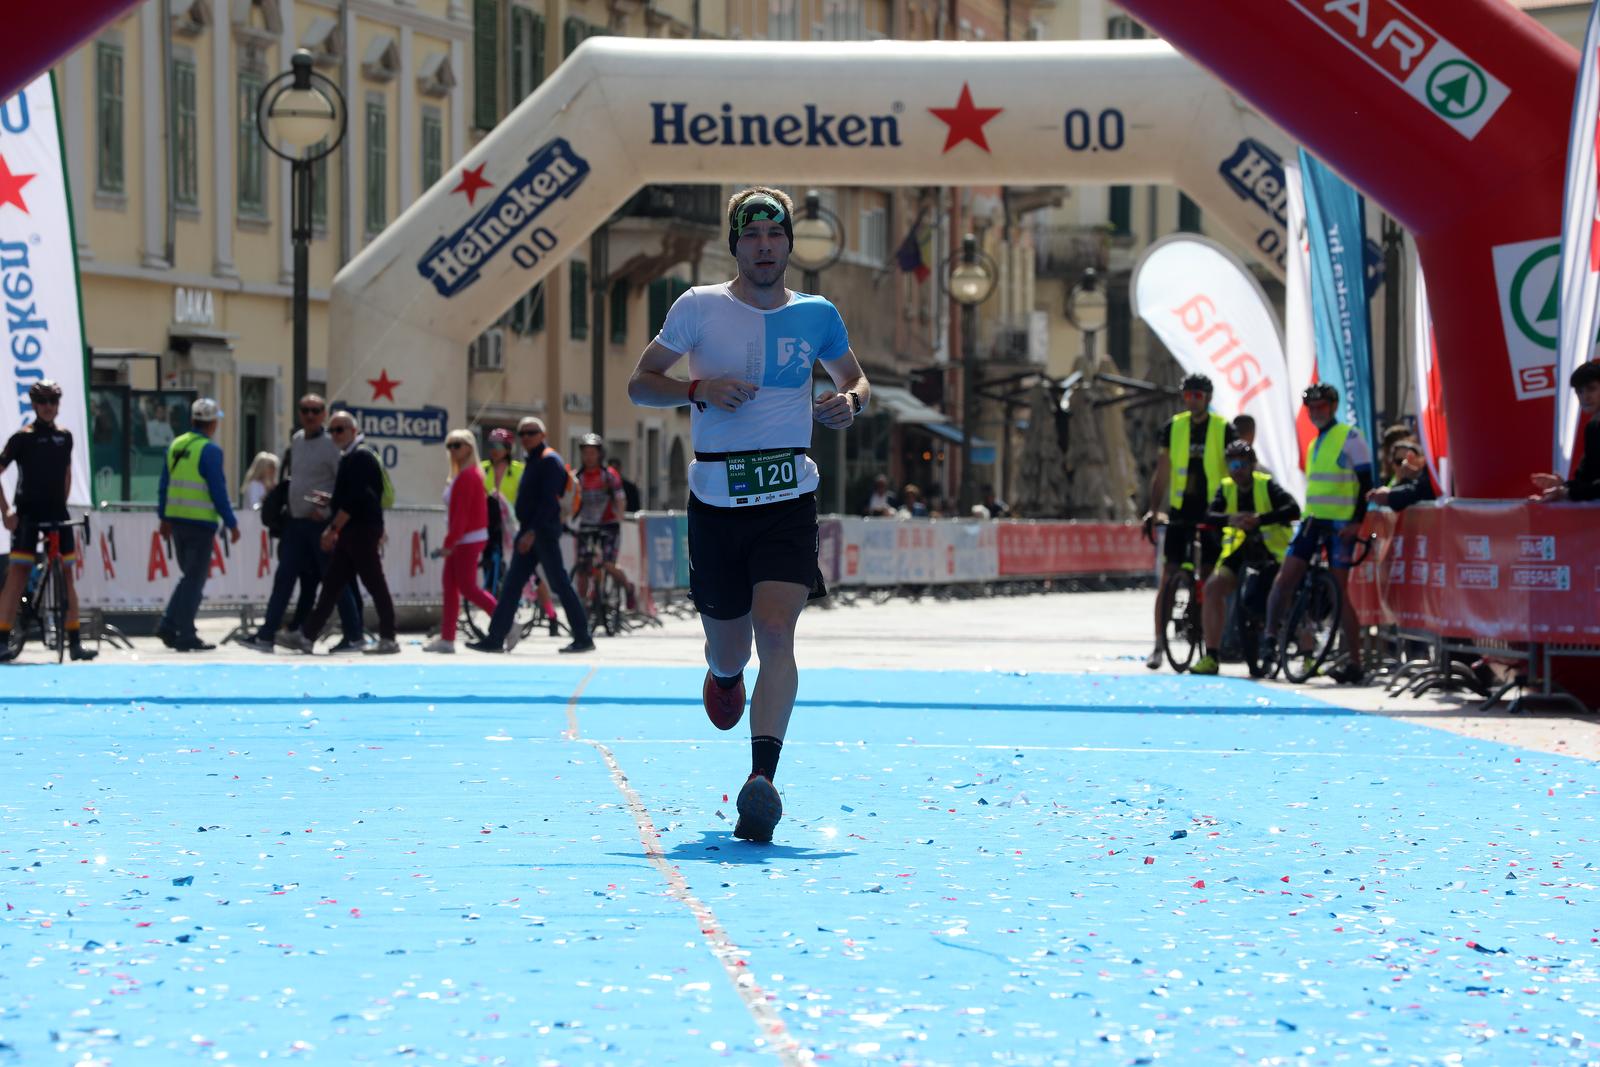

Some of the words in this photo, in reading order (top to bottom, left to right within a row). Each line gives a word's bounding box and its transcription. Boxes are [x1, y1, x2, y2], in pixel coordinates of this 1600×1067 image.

[1323, 0, 1425, 71] AR
[1063, 107, 1126, 154] 0.0
[754, 462, 793, 487] 120
